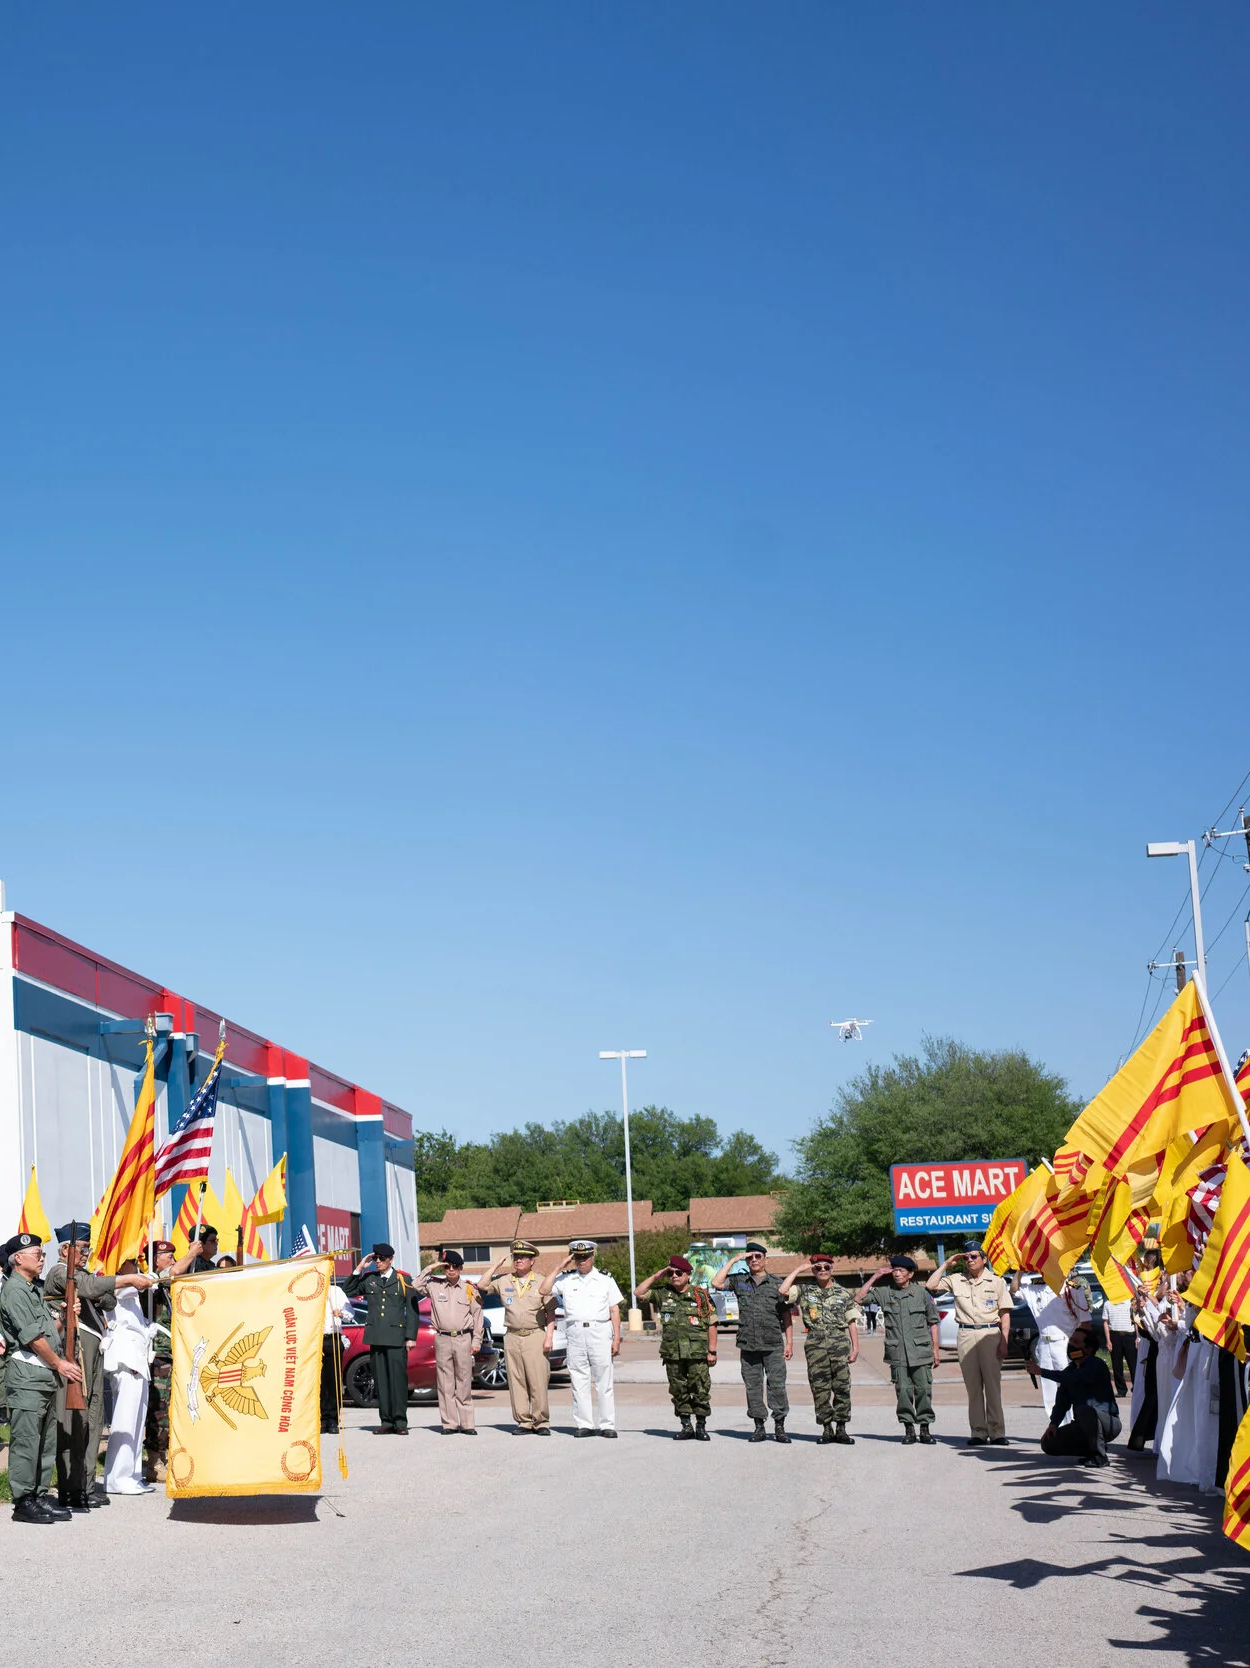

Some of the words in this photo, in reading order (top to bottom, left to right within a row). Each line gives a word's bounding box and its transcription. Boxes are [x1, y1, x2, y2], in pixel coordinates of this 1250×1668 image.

[899, 1170, 947, 1200] ACE
[952, 1166, 1019, 1198] MART
[900, 1213, 979, 1227] RESTAURANT
[327, 1224, 349, 1252] MART
[283, 1347, 298, 1365] VIỆT
[283, 1367, 296, 1387] NAM
[280, 1390, 295, 1413] CỘNG
